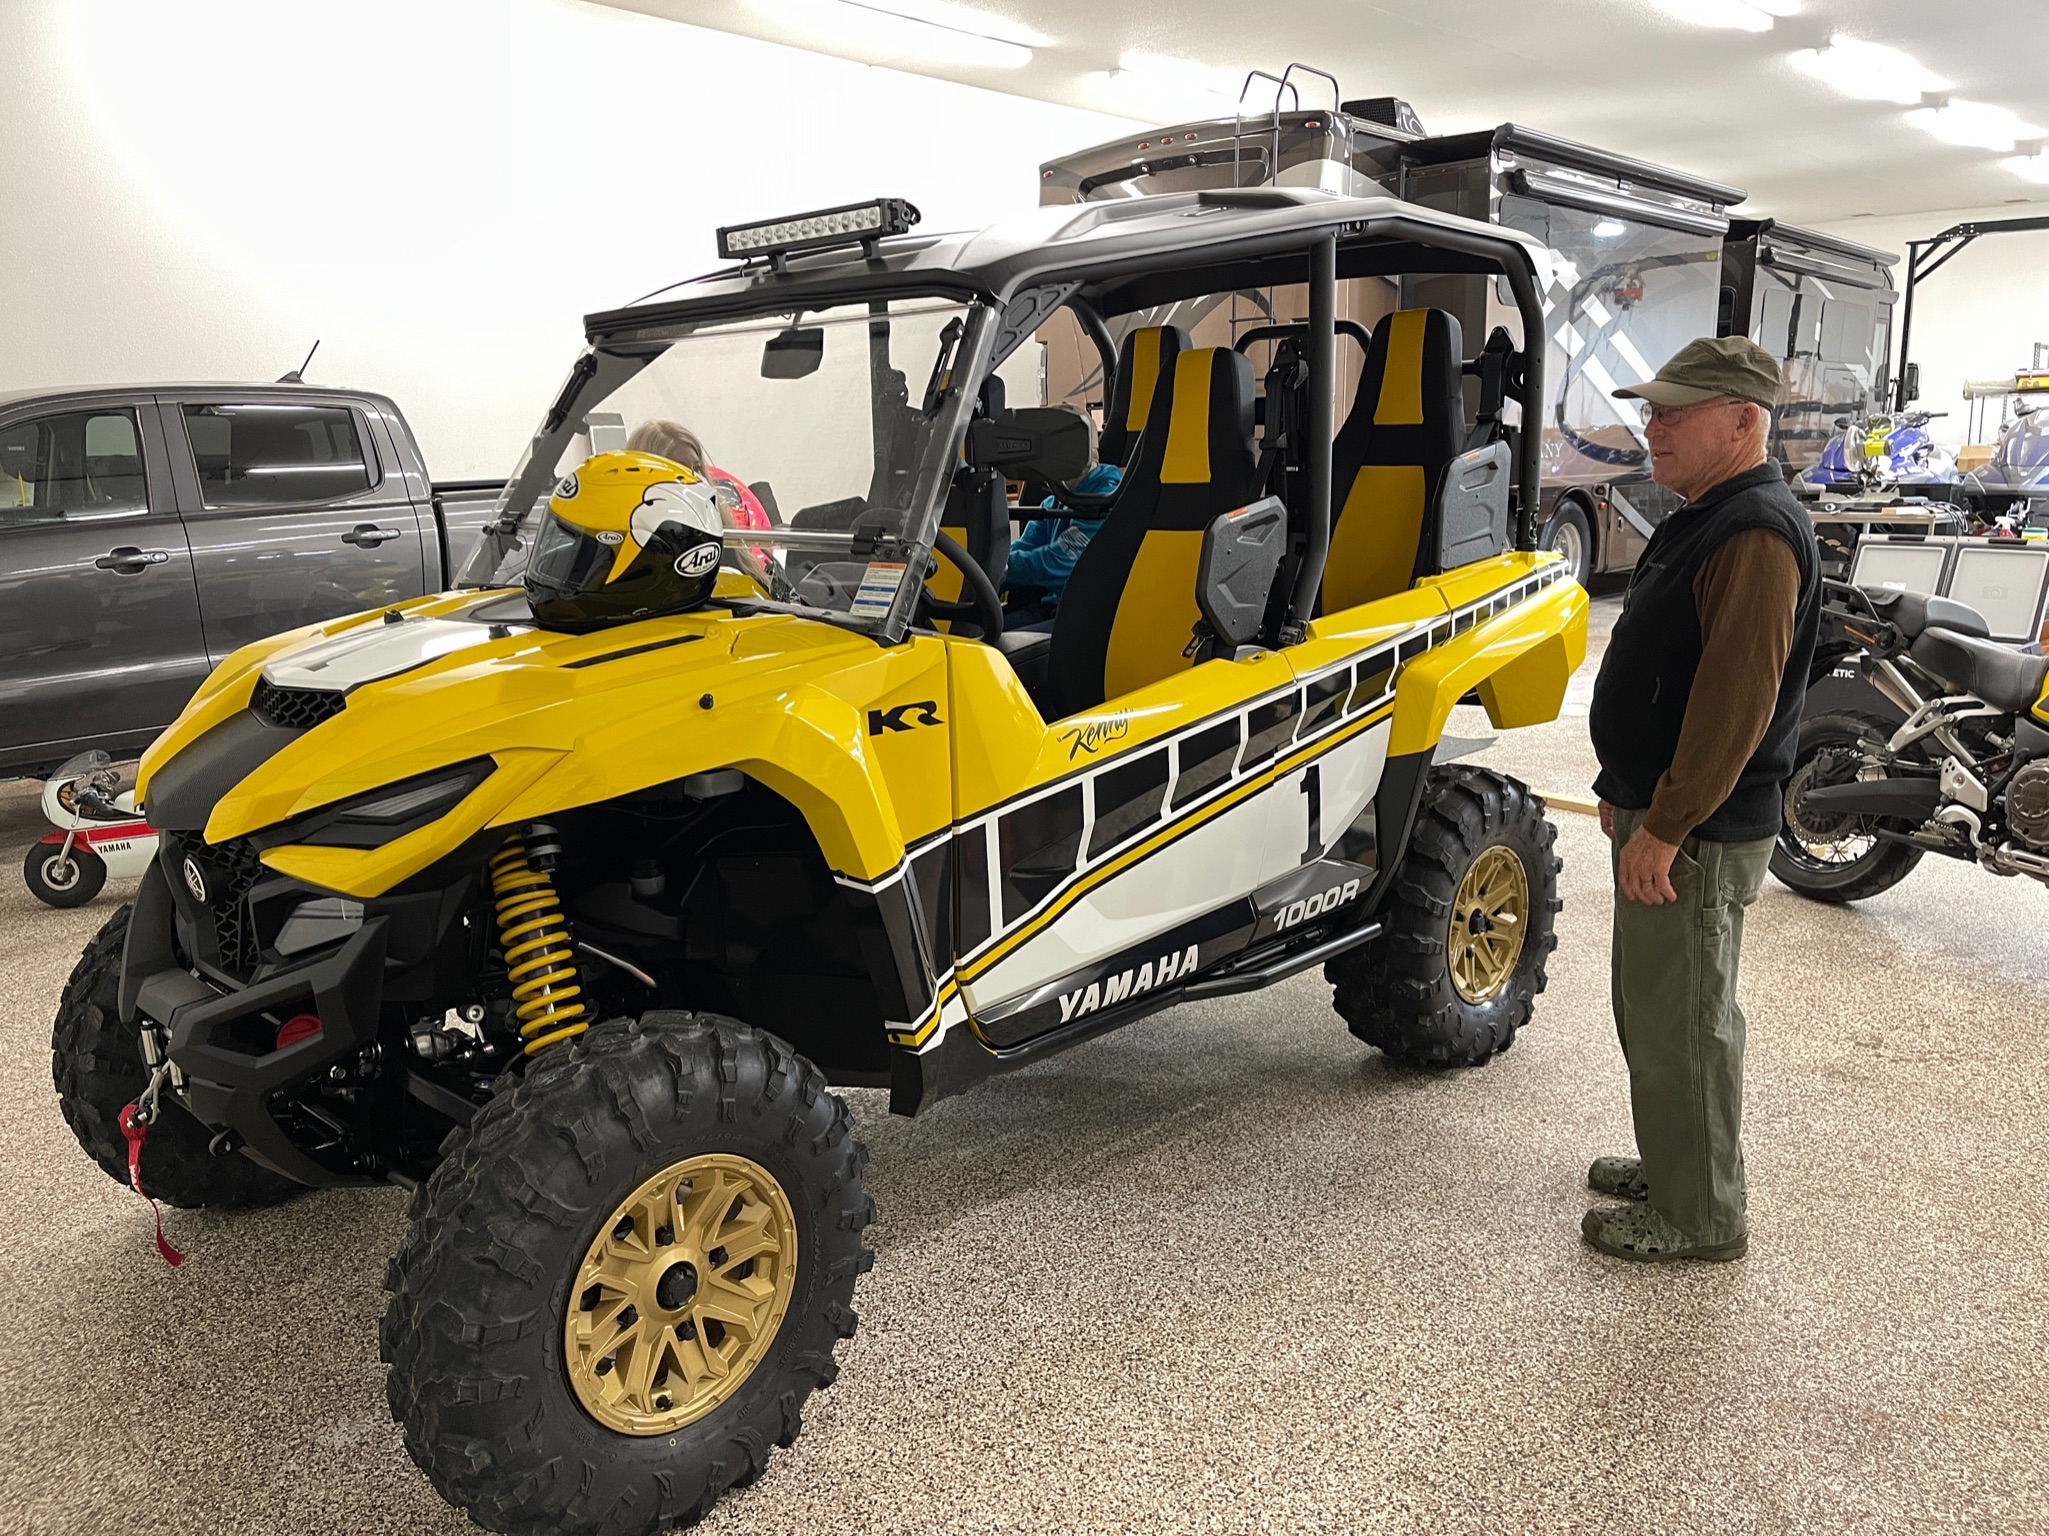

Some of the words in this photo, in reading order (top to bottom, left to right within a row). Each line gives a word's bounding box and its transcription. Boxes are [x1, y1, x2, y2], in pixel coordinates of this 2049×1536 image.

[681, 546, 717, 571] Arai
[1827, 668, 1855, 679] ETIC
[868, 700, 945, 736] KR
[1299, 764, 1326, 866] 1
[98, 842, 132, 854] YAMAHA
[1273, 878, 1360, 932] 1000R
[1058, 943, 1199, 1024] YAMAHA
